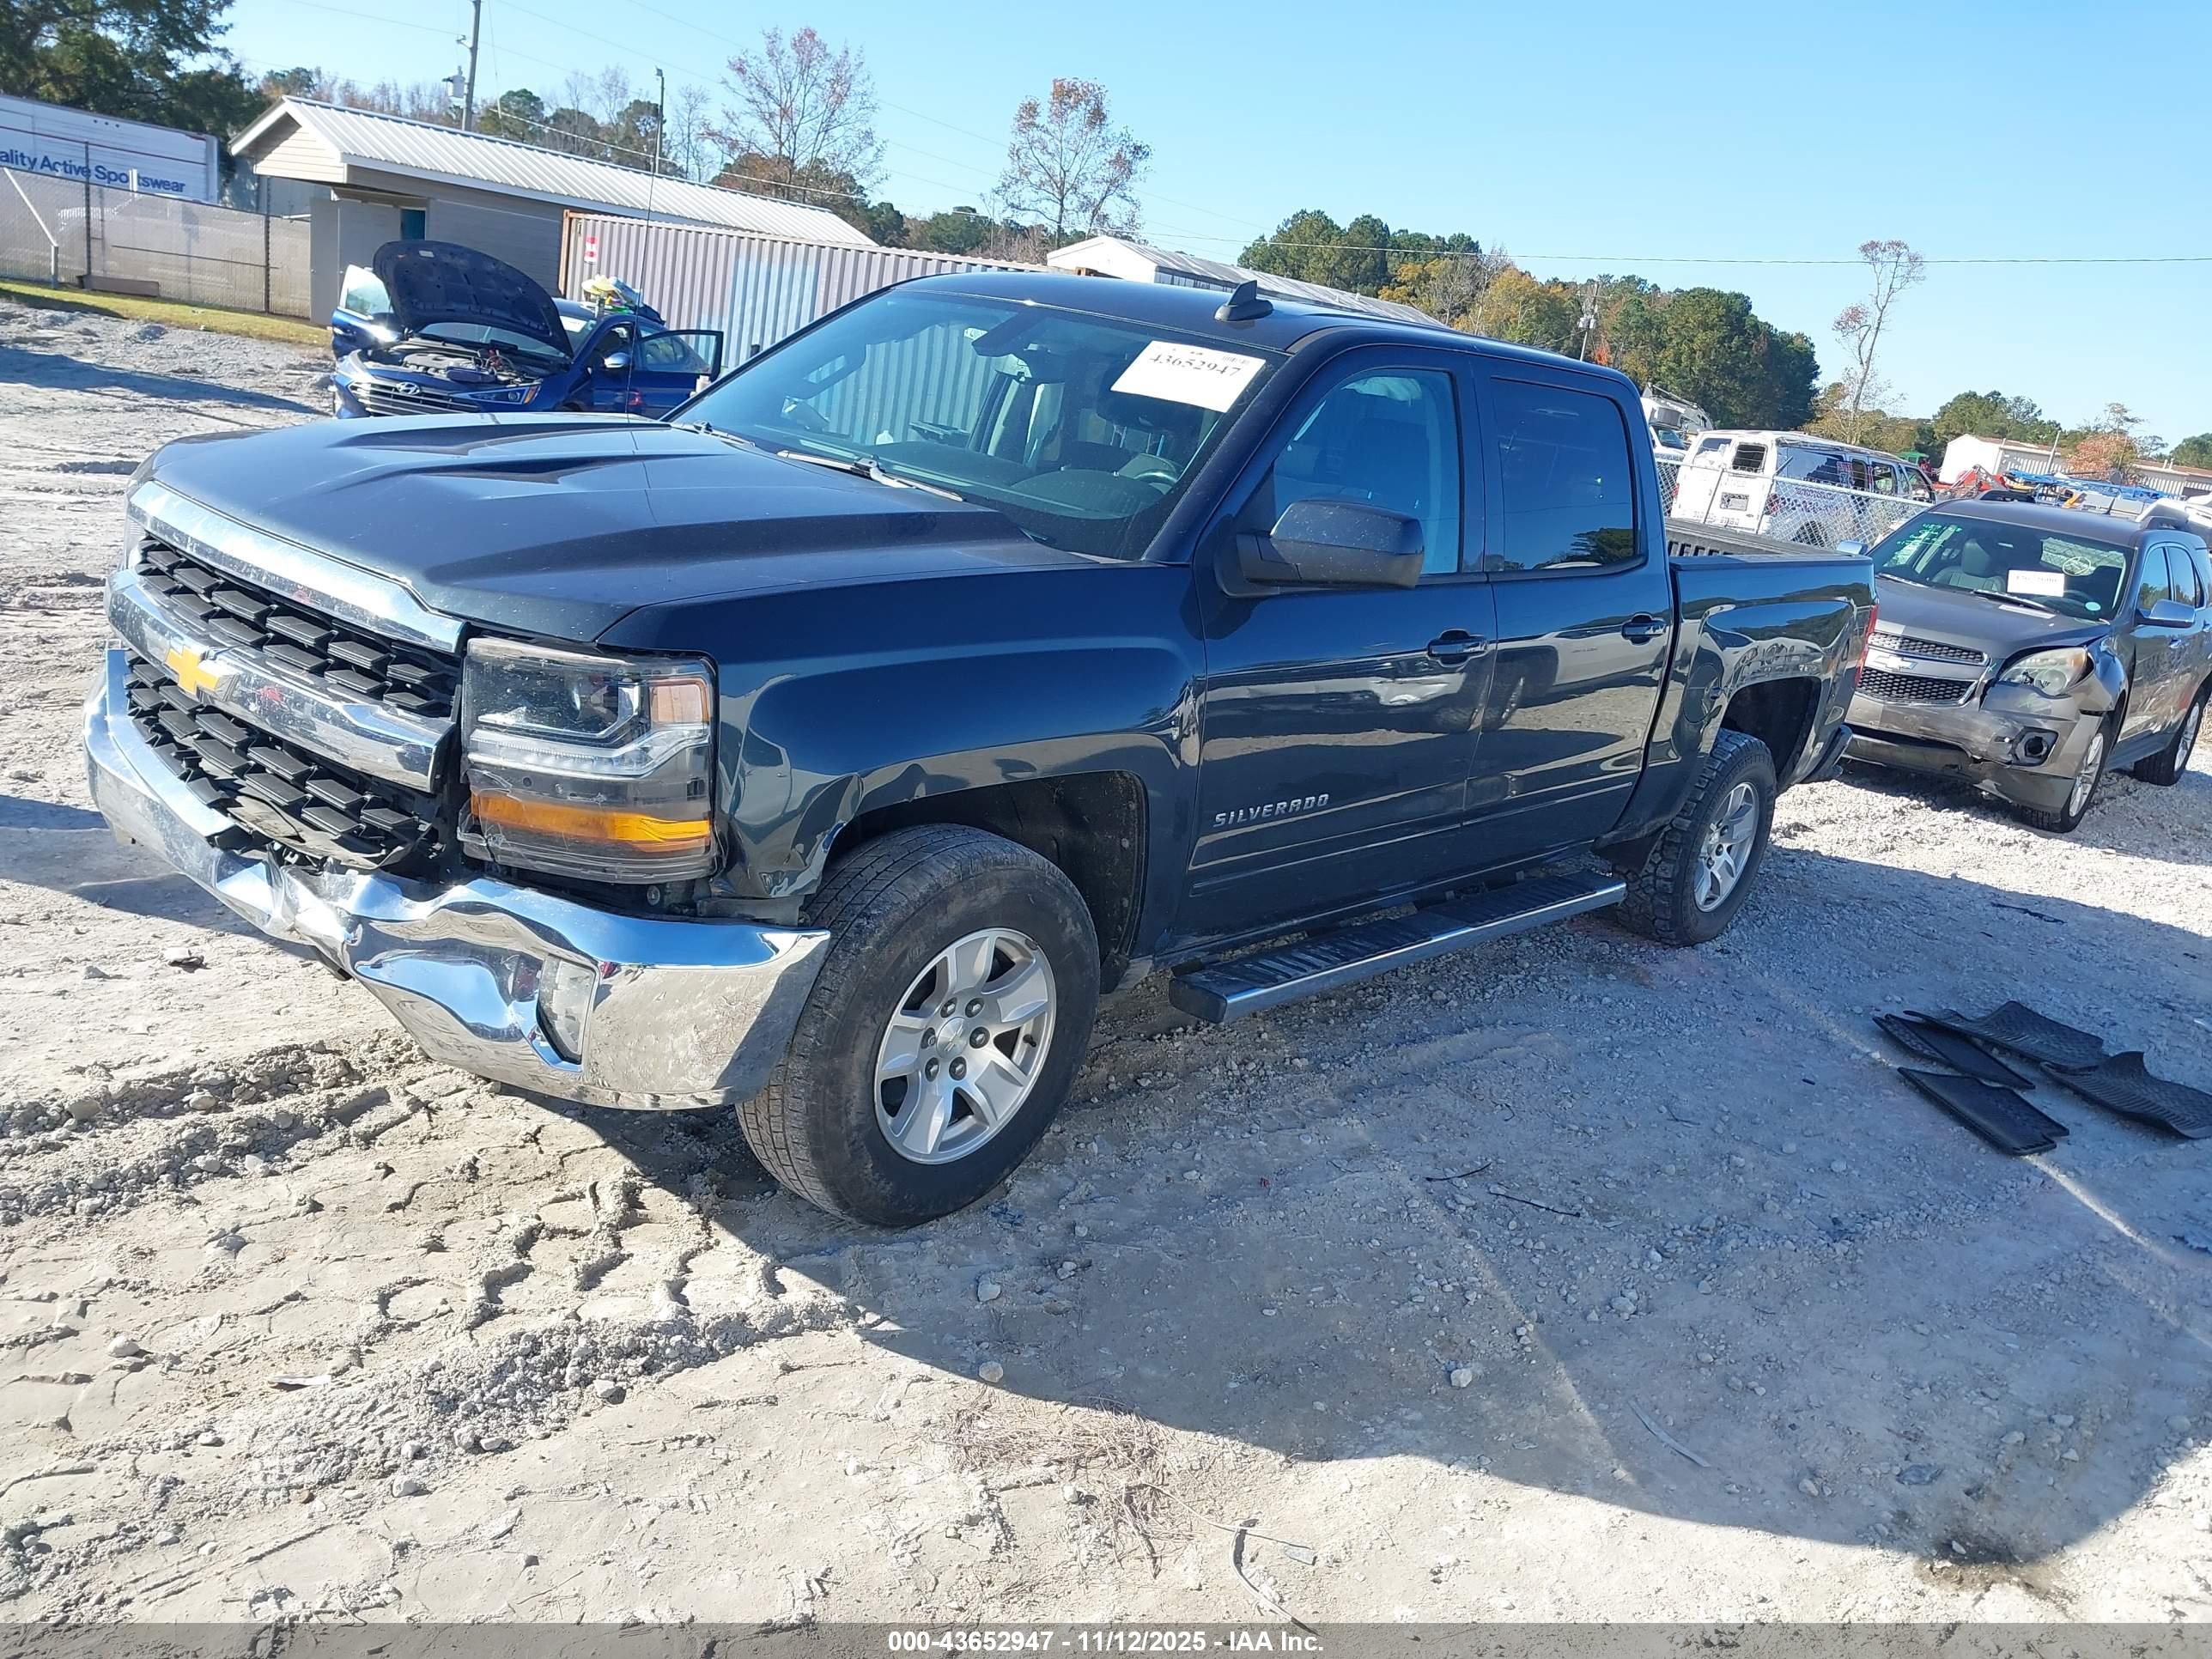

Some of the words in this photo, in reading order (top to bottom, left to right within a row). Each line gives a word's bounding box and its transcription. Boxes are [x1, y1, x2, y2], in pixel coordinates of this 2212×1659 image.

[40, 155, 91, 178] Active
[94, 165, 185, 193] Spotswear
[1149, 353, 1242, 376] 43652947
[1212, 793, 1330, 828] SILVERADO
